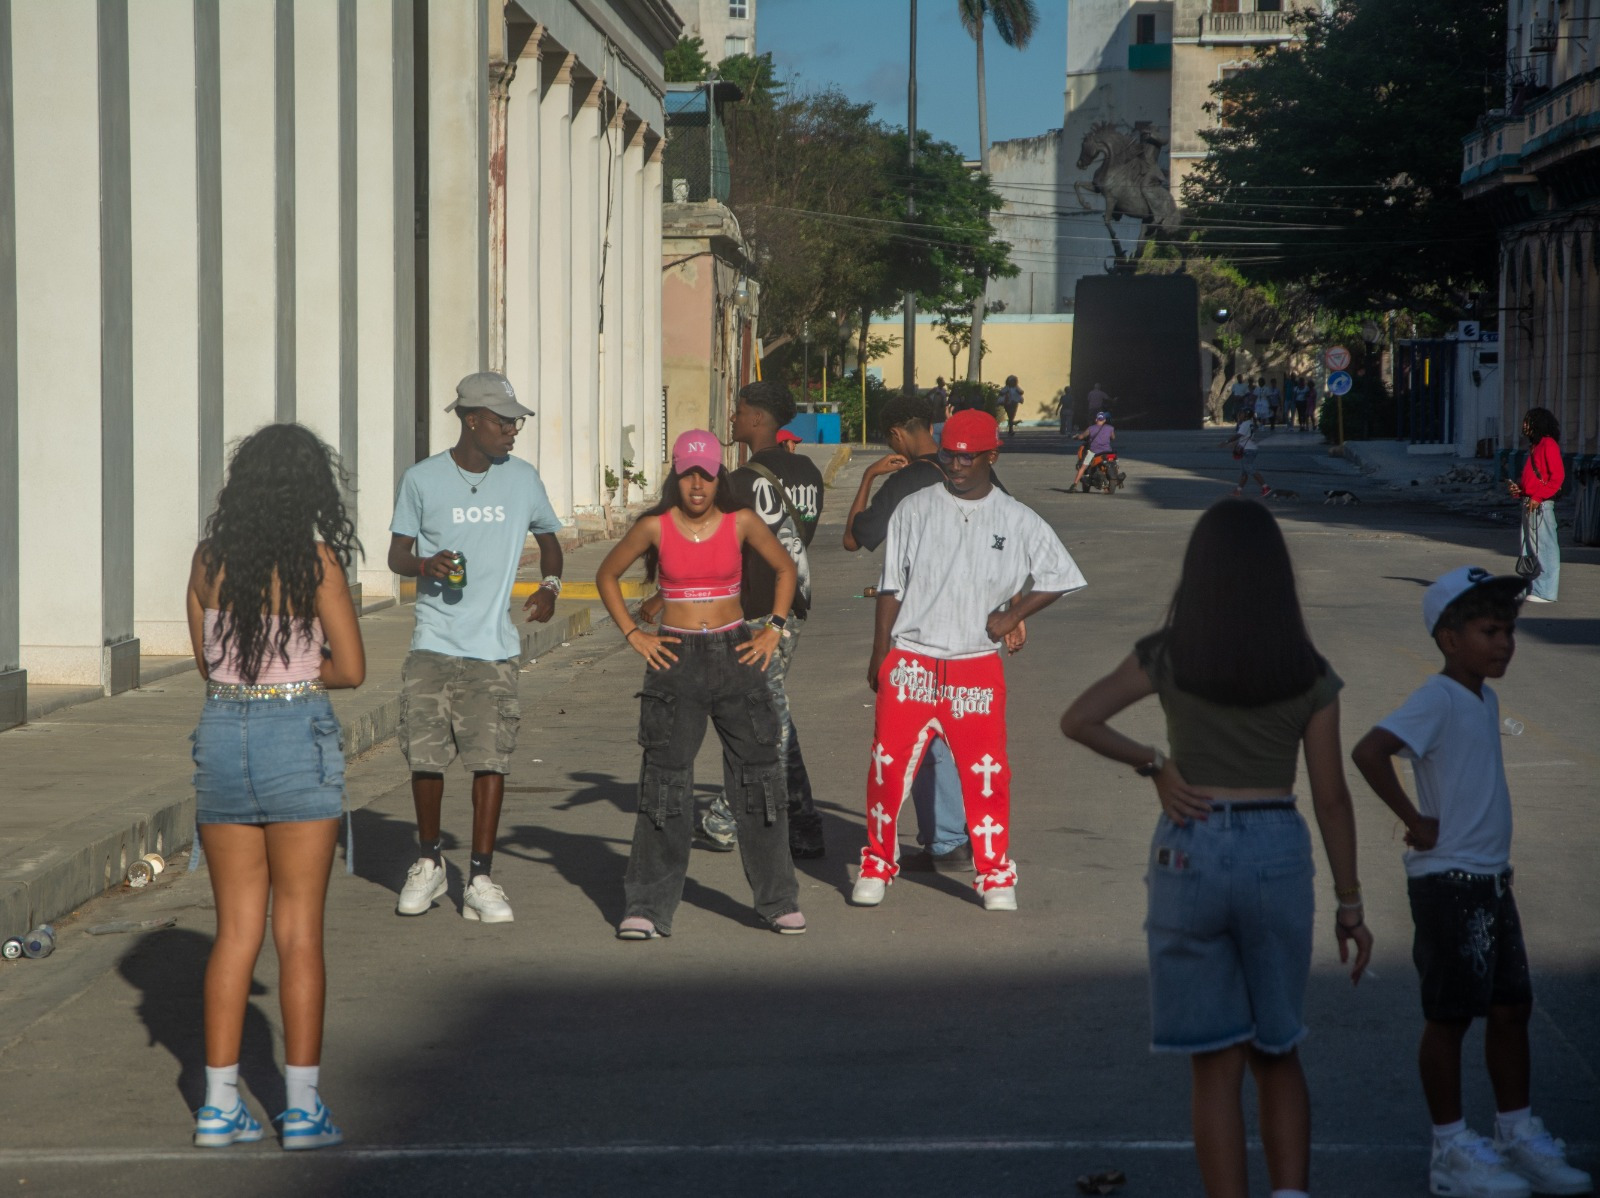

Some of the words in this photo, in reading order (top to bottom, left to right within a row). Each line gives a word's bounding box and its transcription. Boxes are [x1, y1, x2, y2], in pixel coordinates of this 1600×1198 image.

[687, 441, 706, 453] NY
[452, 505, 506, 524] BOSS
[950, 692, 991, 719] god
